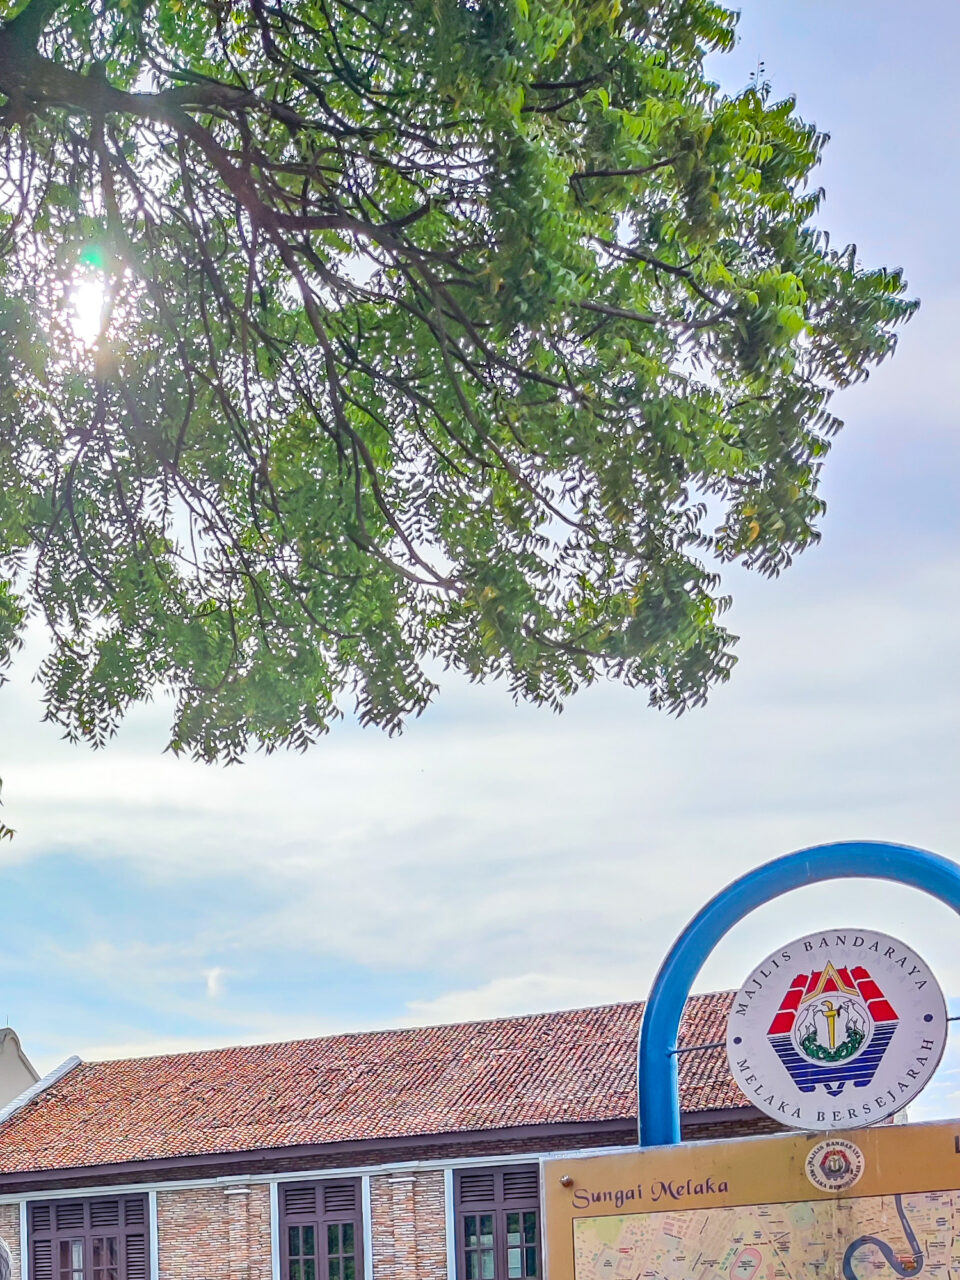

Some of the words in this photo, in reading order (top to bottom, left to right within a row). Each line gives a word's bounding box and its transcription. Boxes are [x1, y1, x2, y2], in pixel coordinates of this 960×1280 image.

[736, 951, 792, 1016] MAJLIS
[803, 935, 928, 991] BANDARAYA
[737, 1059, 801, 1119] MELAKA
[816, 1038, 934, 1122] BERSEJARAH
[572, 1184, 642, 1209] Sungai
[651, 1178, 728, 1202] Melaka
